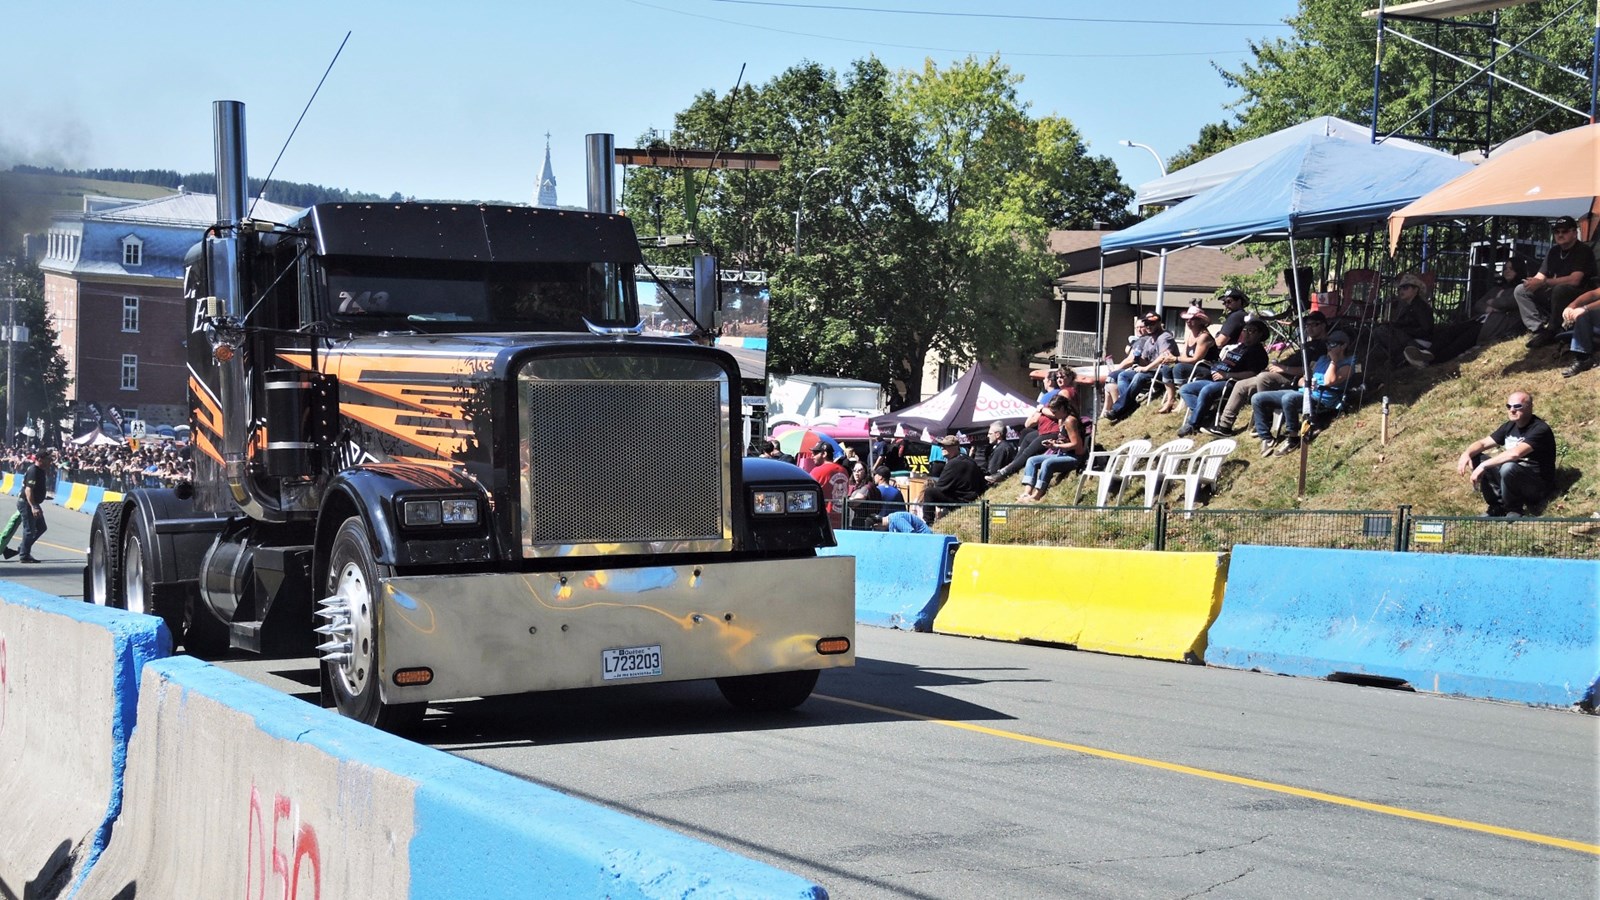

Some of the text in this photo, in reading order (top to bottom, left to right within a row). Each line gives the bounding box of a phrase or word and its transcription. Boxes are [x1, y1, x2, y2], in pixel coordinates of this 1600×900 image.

[975, 396, 1030, 412] Coors
[110, 407, 123, 425] MTA
[988, 409, 1026, 418] LIGHT
[605, 653, 660, 673] L723203
